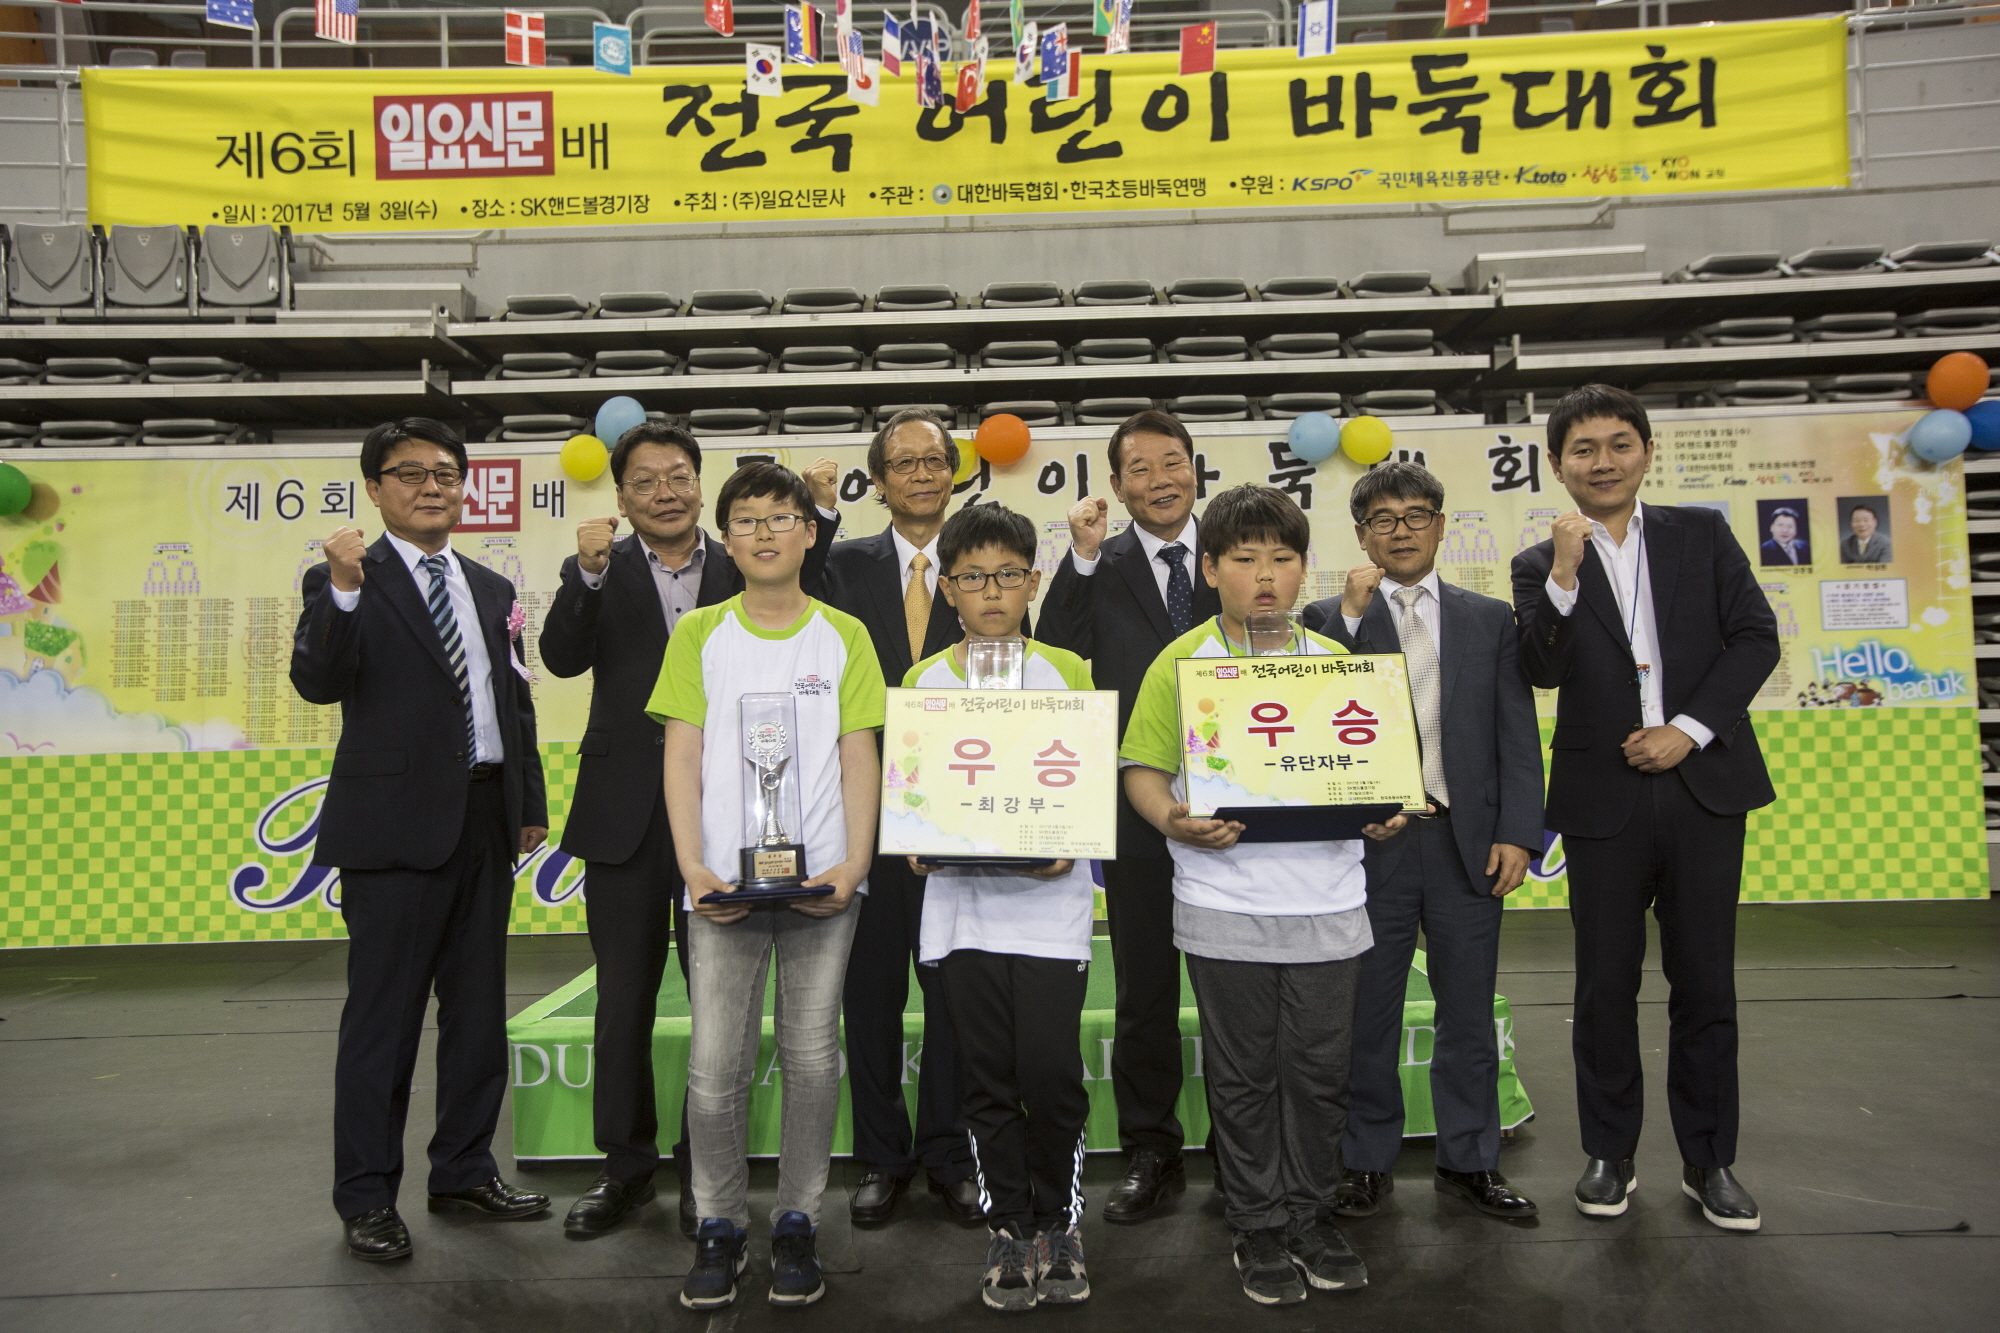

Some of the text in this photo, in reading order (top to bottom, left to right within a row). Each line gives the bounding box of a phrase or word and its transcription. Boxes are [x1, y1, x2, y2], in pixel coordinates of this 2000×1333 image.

[215, 129, 356, 179] 제6회
[380, 101, 545, 171] 일요신문
[562, 122, 609, 170] 배
[663, 75, 860, 172] 전국
[1290, 45, 1717, 154] 바둑대회
[1292, 177, 1353, 191] KSPO
[1377, 169, 1500, 189] 국민체육진흥공단
[520, 194, 650, 216] SK핸드볼경기장
[732, 188, 846, 211] (주)일요신문사
[272, 203, 333, 223] 2017년
[343, 202, 370, 221] 5월
[380, 200, 438, 221] 3일(수)
[533, 480, 565, 518] 배
[1321, 659, 1375, 677] 바둑대회
[1884, 669, 1967, 701] baduk
[1031, 697, 1085, 713] 바둑대회
